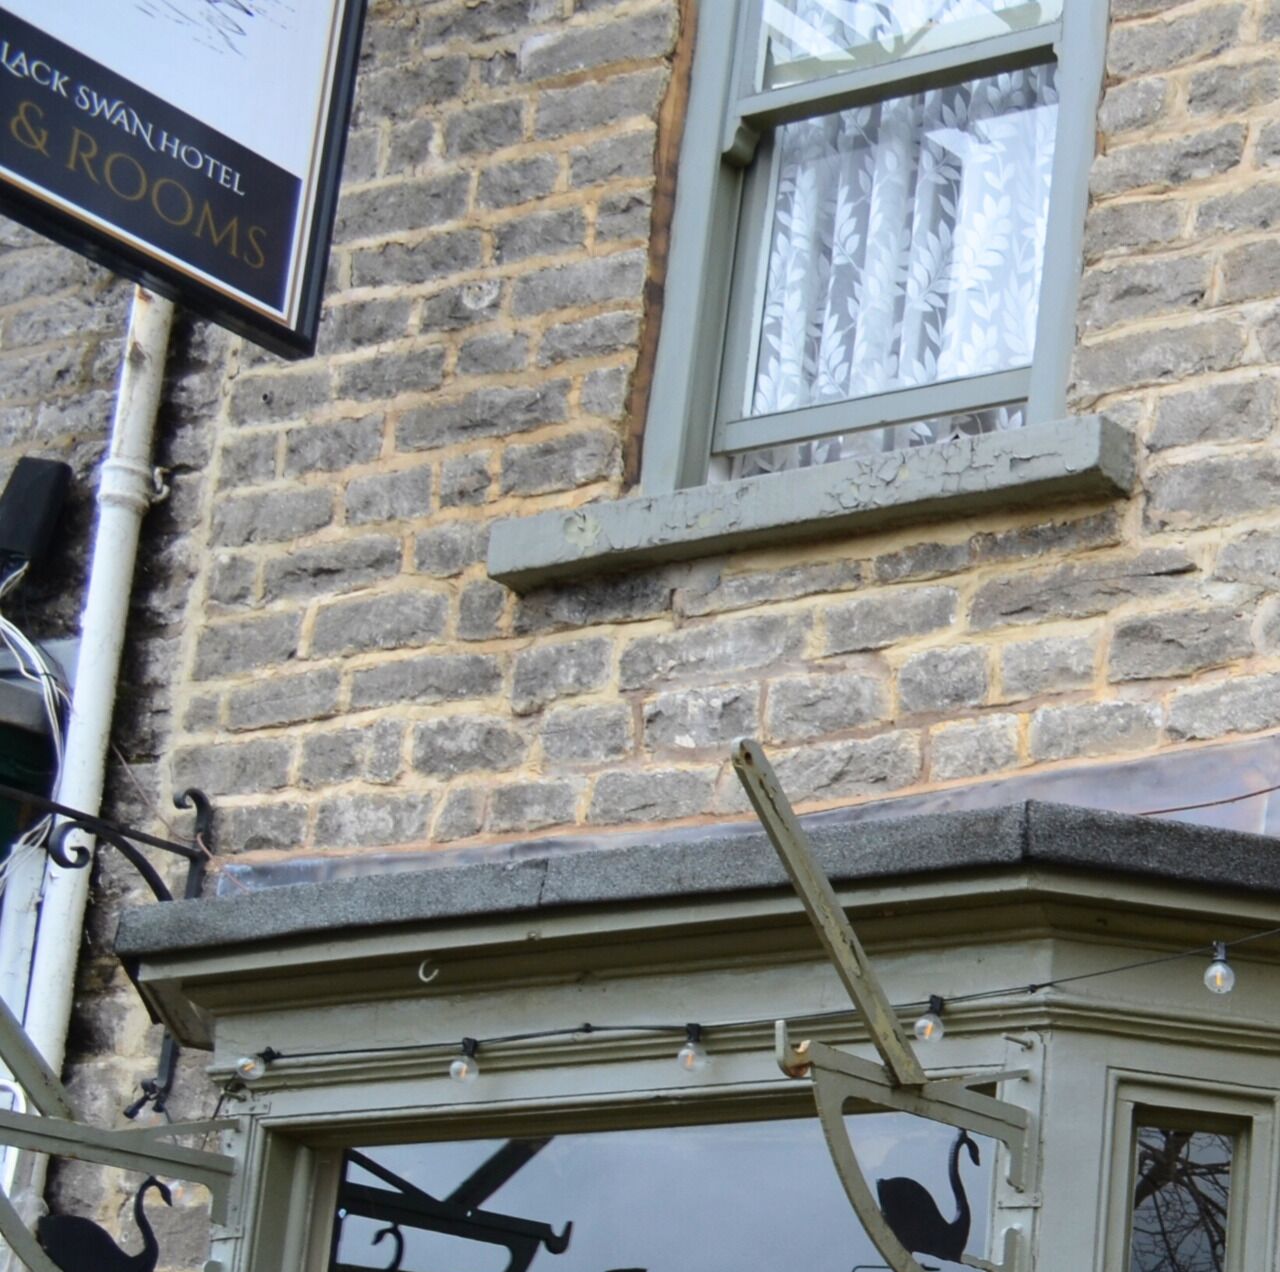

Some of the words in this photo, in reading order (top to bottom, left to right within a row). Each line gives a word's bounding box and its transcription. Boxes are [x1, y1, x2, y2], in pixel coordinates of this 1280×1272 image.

[10, 101, 50, 157] &
[66, 127, 267, 270] ROOMS
[75, 85, 156, 152] SWAN
[160, 131, 246, 196] HOTEL
